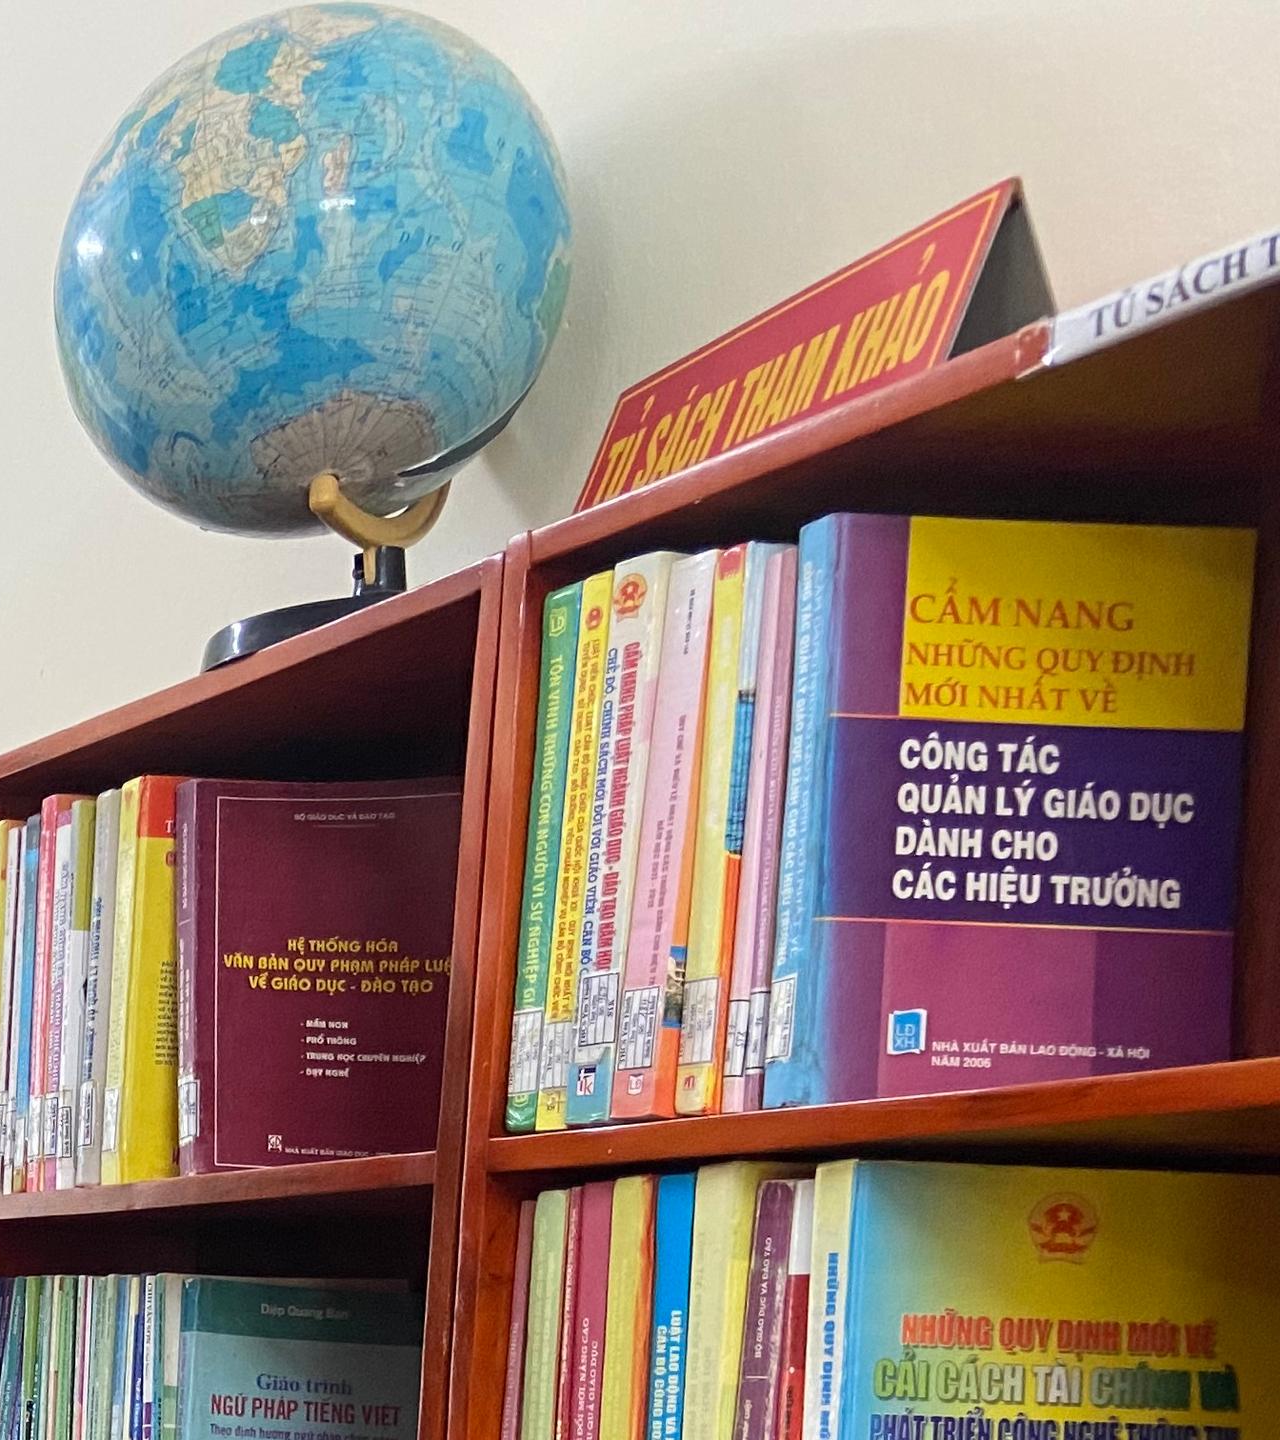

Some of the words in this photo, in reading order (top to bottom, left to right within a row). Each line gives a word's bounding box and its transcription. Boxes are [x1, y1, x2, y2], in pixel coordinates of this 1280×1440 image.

[1089, 288, 1137, 337] TỦ
[1145, 247, 1249, 316] SÁCH
[592, 394, 655, 505] TỦ
[629, 383, 737, 491] SÁCH
[722, 323, 841, 452] THAM
[822, 242, 950, 401] KHẢO
[909, 577, 1000, 626] CẨM
[1014, 599, 1135, 632] NANG
[547, 656, 565, 686] TÔN
[905, 639, 1026, 670] NHỮNG
[1036, 647, 1107, 676] QUY
[1111, 651, 1195, 680] ĐỊNH
[544, 689, 562, 731] VINH
[904, 677, 968, 708] MỚI
[978, 676, 1070, 710] NHẤT
[1079, 677, 1117, 714] VỀ
[540, 734, 562, 791] NHỮNG
[899, 731, 989, 772] CÔNG
[999, 735, 1061, 775] TÁC
[537, 794, 555, 826] CON
[897, 773, 986, 815] QUẢN
[995, 780, 1037, 817] LÝ
[1044, 782, 1120, 819] GIÁO
[1129, 793, 1195, 829] DỤC
[532, 829, 551, 879] NGƯỜI
[895, 818, 982, 858] DÀNH
[991, 831, 1059, 862] CHO
[531, 881, 550, 898] VÌ
[892, 863, 956, 901] CÁC
[965, 866, 1041, 910] HIỆU
[1049, 867, 1182, 910] TRƯỞNG
[526, 901, 546, 923] SỰ
[224, 954, 254, 970] VĂN
[258, 953, 289, 971] BẢN
[293, 959, 325, 973] QUY
[331, 959, 374, 975] PHẠM
[379, 957, 420, 973] PHÁP
[288, 936, 305, 957] HỆ
[309, 936, 361, 953] THỐNG
[366, 940, 398, 953] HÓA
[522, 927, 544, 984] NGHIỆP
[249, 972, 267, 989] VỀ
[271, 976, 311, 991] GIÁO
[316, 978, 346, 996] DỤC
[360, 976, 396, 992] ĐÀO
[401, 980, 433, 996] TẠO
[306, 1053, 334, 1061] TRUNG
[326, 1034, 357, 1046] THÔNG
[932, 1040, 959, 1054] NHÀ
[963, 1039, 997, 1055] XUẤT
[1000, 1040, 1027, 1055] BẢN
[1030, 1043, 1057, 1056] LAO
[931, 1055, 960, 1068] NĂM
[901, 1307, 992, 1349] NHỮNG
[999, 1317, 1051, 1355] QUY
[1057, 1318, 1121, 1361] ĐỊNH
[256, 1372, 300, 1392] Giáo
[306, 1376, 353, 1395] trình
[873, 1349, 931, 1400] CẢI
[939, 1356, 1025, 1404] CÁCH
[1033, 1357, 1082, 1407] TÀI
[211, 1392, 247, 1417] NGỮ
[251, 1394, 299, 1420] PHÁP
[303, 1394, 355, 1425] TIẾNG
[361, 1404, 401, 1426] VIỆT
[210, 1423, 231, 1438] Theo
